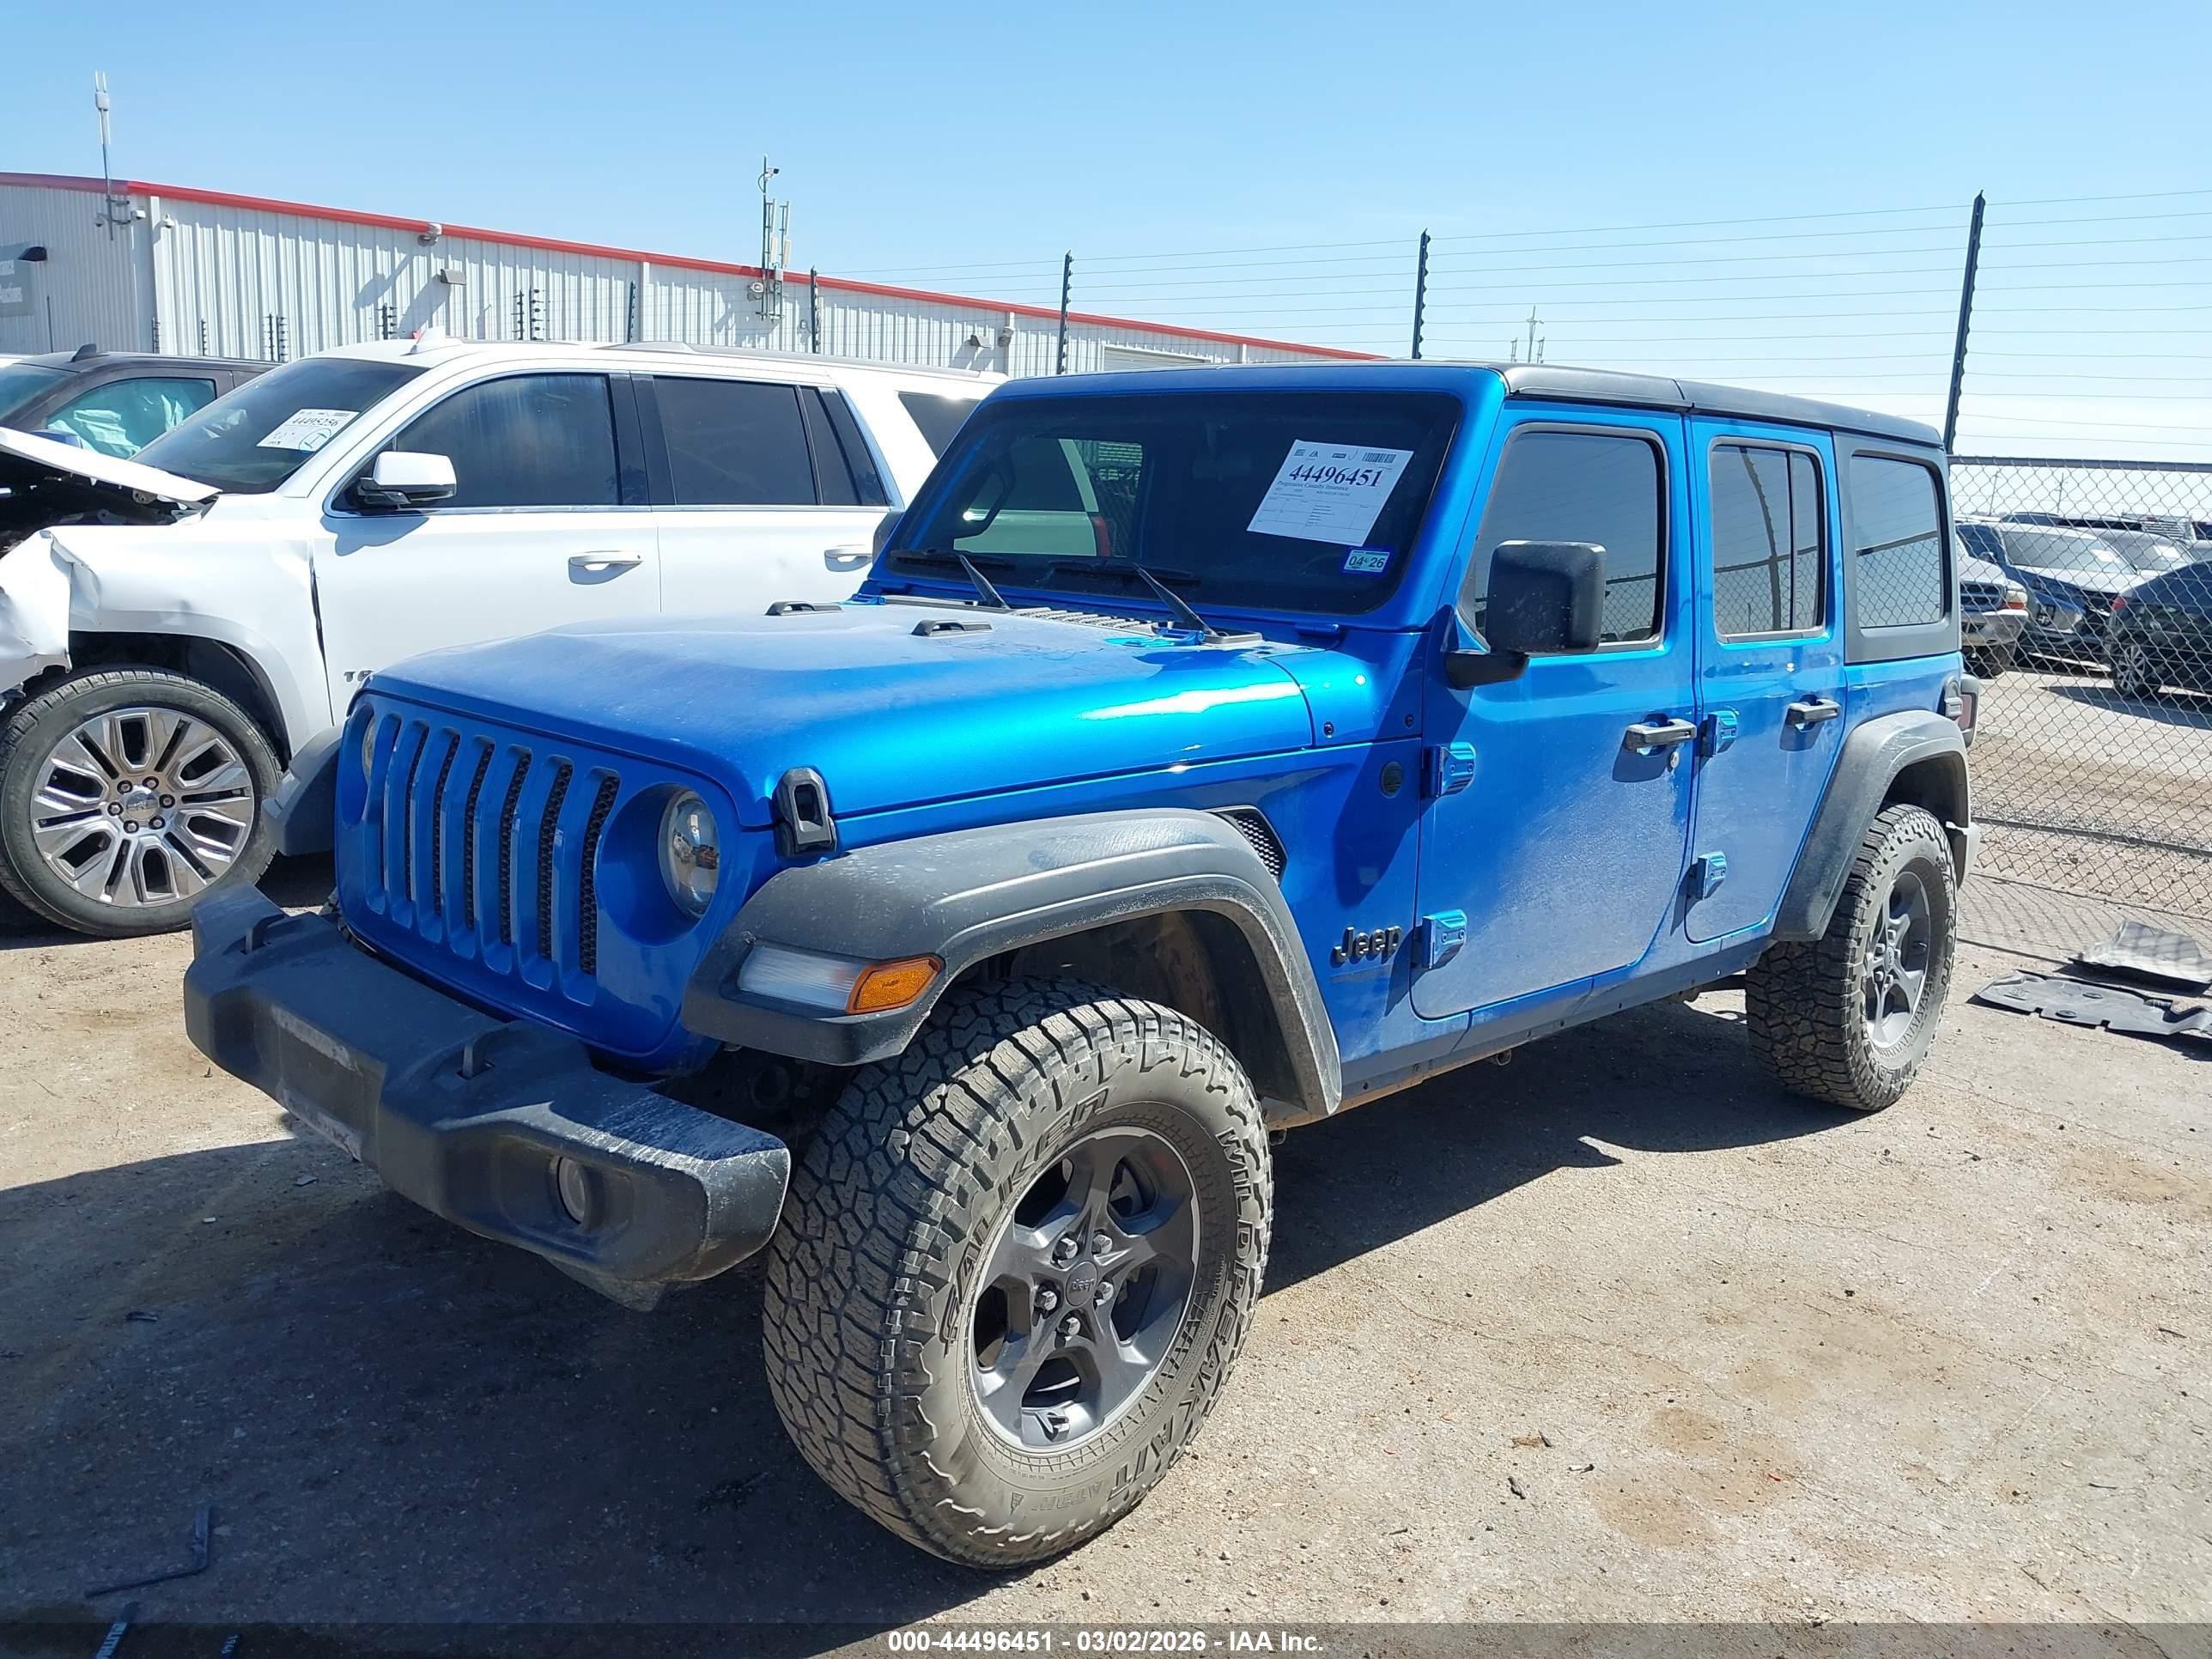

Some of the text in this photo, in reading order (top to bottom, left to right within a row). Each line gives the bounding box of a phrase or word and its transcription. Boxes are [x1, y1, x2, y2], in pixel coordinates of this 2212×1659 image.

[1289, 464, 1383, 488] 44496451
[1348, 556, 1386, 568] 04 26
[1333, 926, 1401, 964] Jeep
[1178, 1126, 1251, 1423] WILDPEAK
